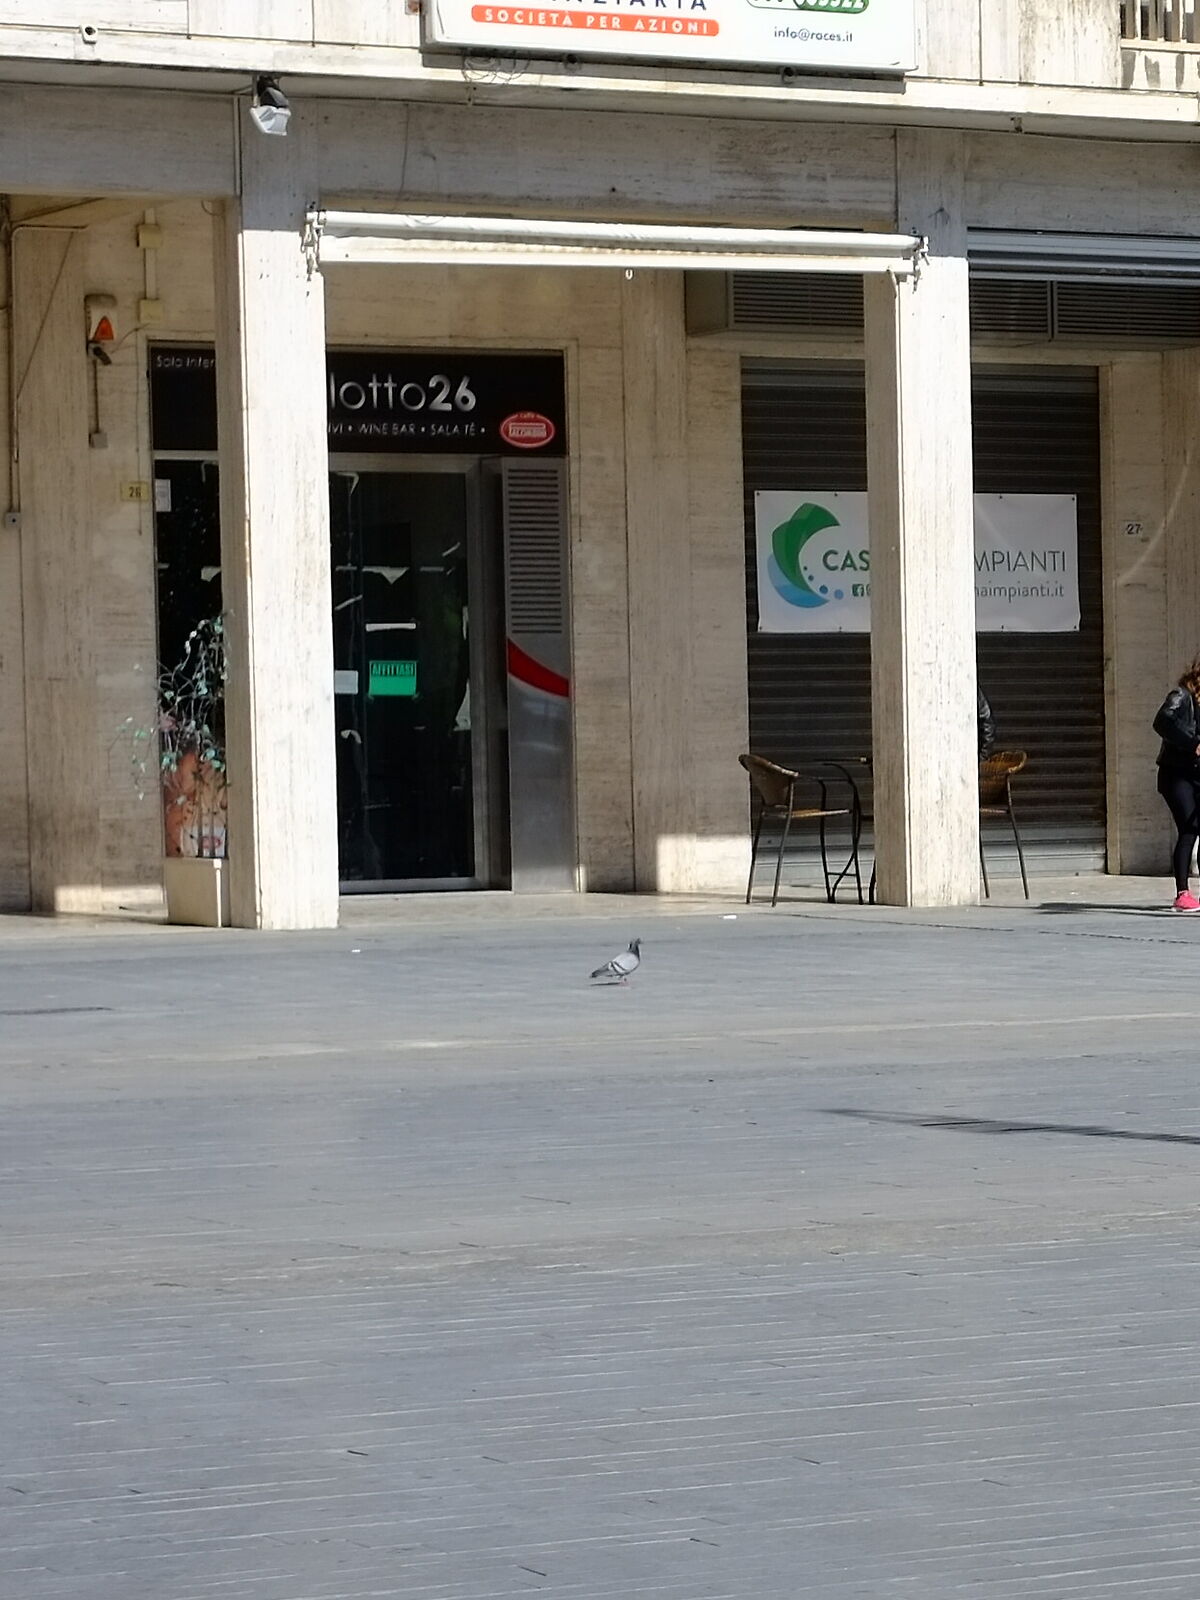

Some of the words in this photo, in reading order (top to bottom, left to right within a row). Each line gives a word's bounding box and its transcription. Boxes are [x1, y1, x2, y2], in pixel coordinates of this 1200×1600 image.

[485, 8, 573, 26] SOCIETÀ
[586, 14, 621, 29] PER
[634, 18, 709, 34] AZIONI
[329, 372, 477, 412] lotto26
[359, 422, 389, 435] WINE
[392, 423, 416, 436] BAR
[430, 423, 460, 436] SALA
[1127, 523, 1142, 535] 27
